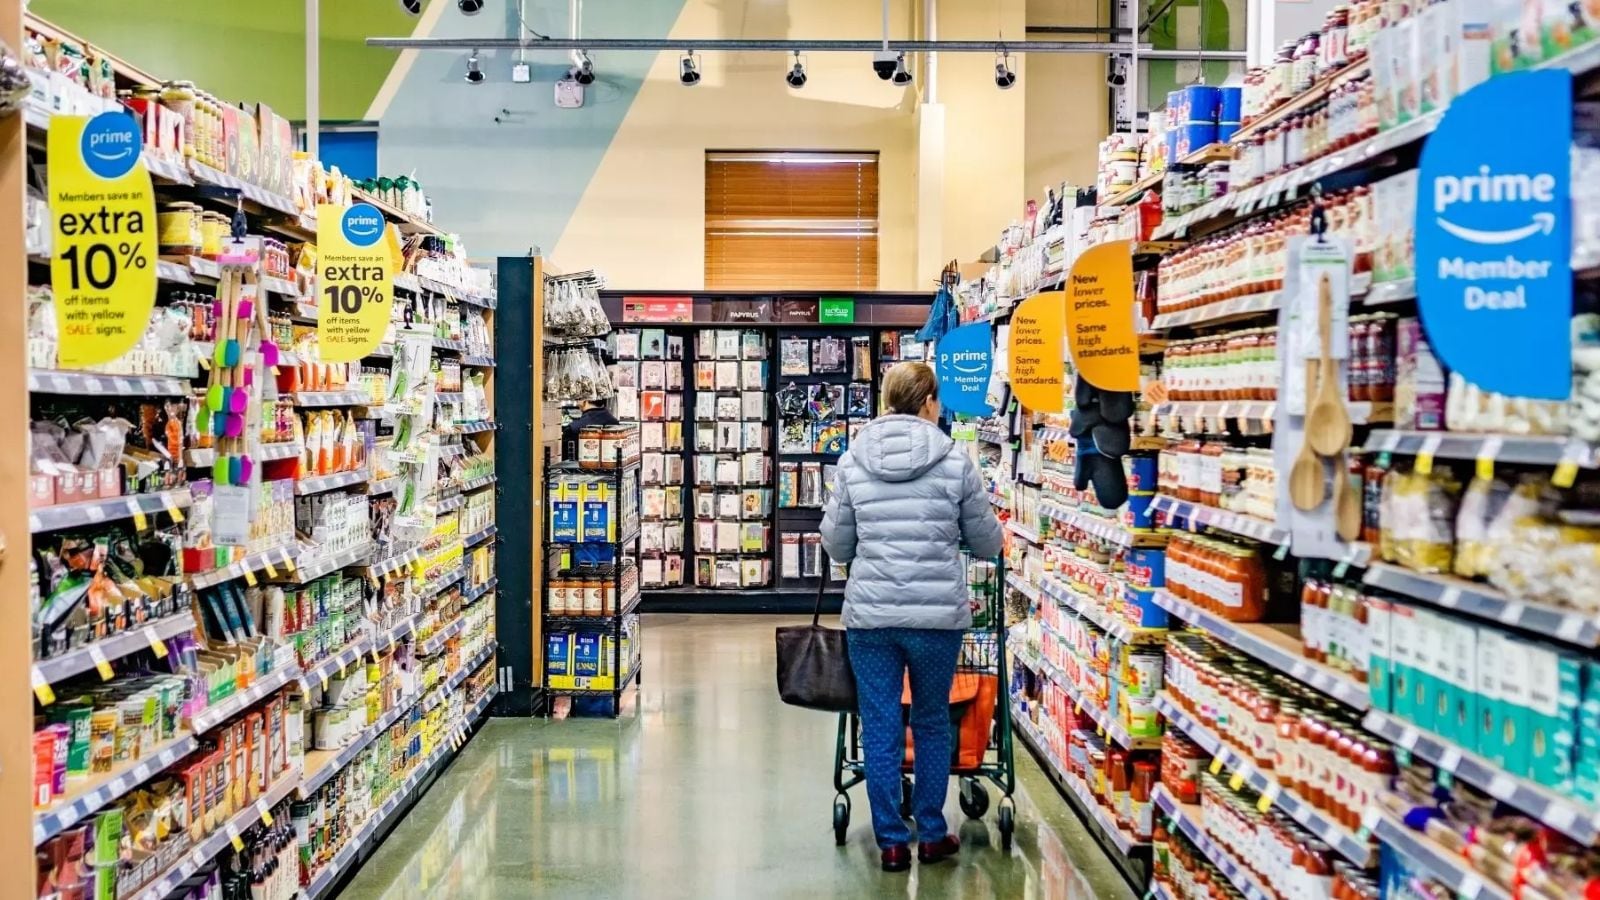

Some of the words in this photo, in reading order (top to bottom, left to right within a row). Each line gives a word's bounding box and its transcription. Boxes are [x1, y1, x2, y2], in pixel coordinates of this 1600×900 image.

[90, 128, 133, 148] prime
[1434, 164, 1556, 213] prime
[58, 192, 105, 202] Members
[107, 192, 128, 200] save
[131, 192, 143, 200] an
[60, 206, 144, 236] extra
[348, 215, 378, 227] prime
[60, 242, 147, 290] 10%
[1438, 255, 1551, 280] Member
[325, 263, 384, 281] extra
[1073, 275, 1098, 284] New
[1074, 286, 1105, 297] lower
[64, 295, 79, 306] off
[81, 295, 110, 305] items
[324, 285, 383, 314] 10%
[1464, 285, 1526, 310] Deal
[1074, 299, 1110, 311] prices.
[66, 311, 88, 320] with
[91, 309, 124, 321] yellow
[1016, 316, 1036, 324] New
[326, 317, 338, 325] off
[339, 317, 360, 325] items
[65, 324, 93, 336] SALE
[96, 325, 126, 337] signs.
[346, 326, 370, 335] yellow
[1016, 327, 1040, 335] lower
[1076, 323, 1107, 333] Same
[347, 336, 368, 344] signs.
[1016, 338, 1045, 346] prices.
[1076, 335, 1102, 347] high
[953, 349, 988, 363] prime
[1078, 345, 1134, 359] standards.
[1016, 356, 1040, 365] Same
[1015, 367, 1035, 376] high
[954, 375, 987, 384] Member
[1015, 376, 1062, 385] standards.
[961, 384, 980, 392] Deal
